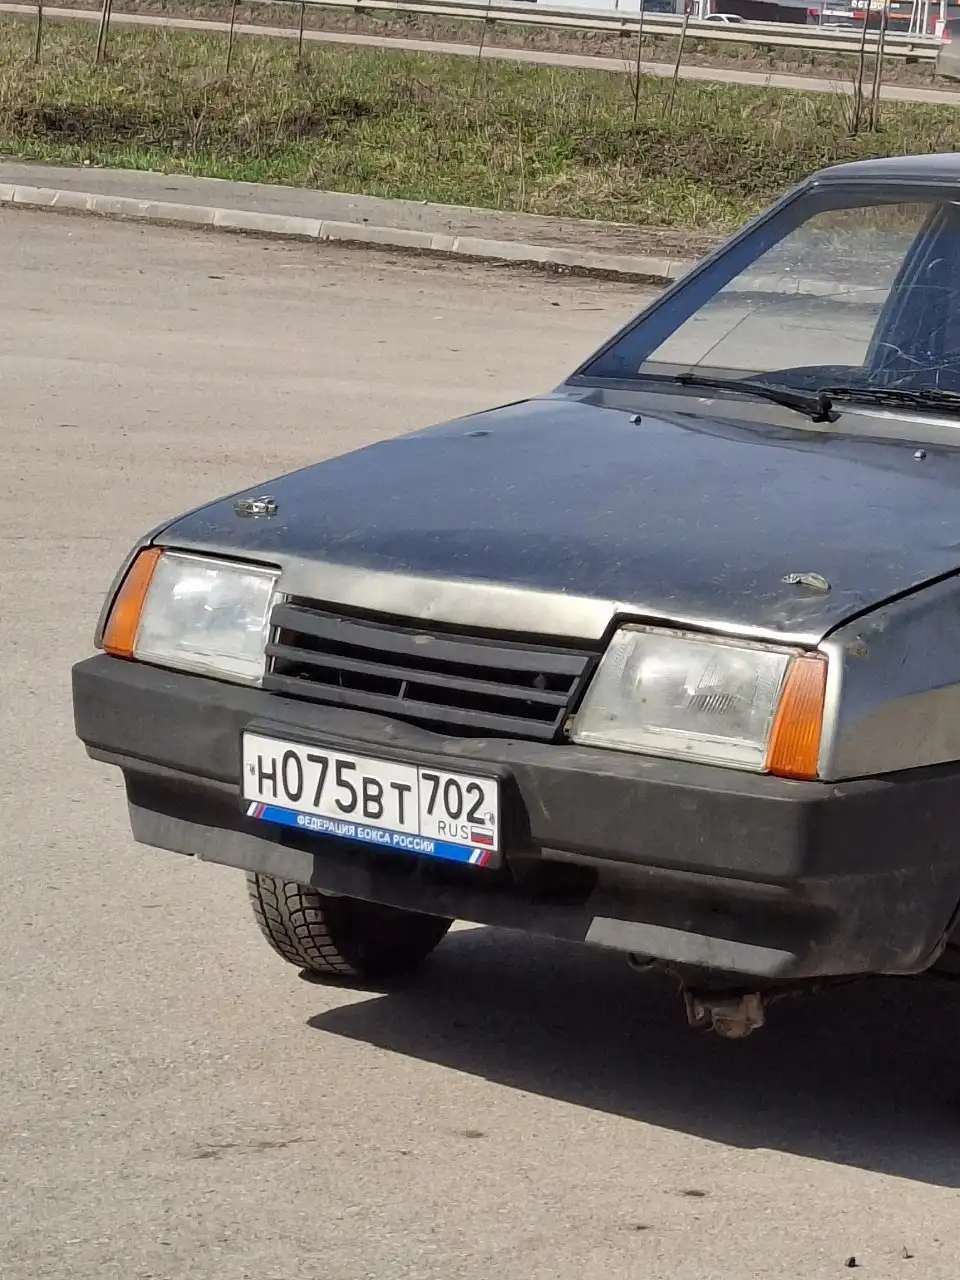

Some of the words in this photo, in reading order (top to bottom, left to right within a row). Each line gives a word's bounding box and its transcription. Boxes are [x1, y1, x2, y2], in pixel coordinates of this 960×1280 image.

[422, 773, 486, 825] 702
[297, 815, 356, 837] ФЕДЕРАЦИЯ
[357, 827, 391, 844] БОКСА
[393, 835, 435, 853] РОССИИ
[437, 820, 469, 839] RUS
